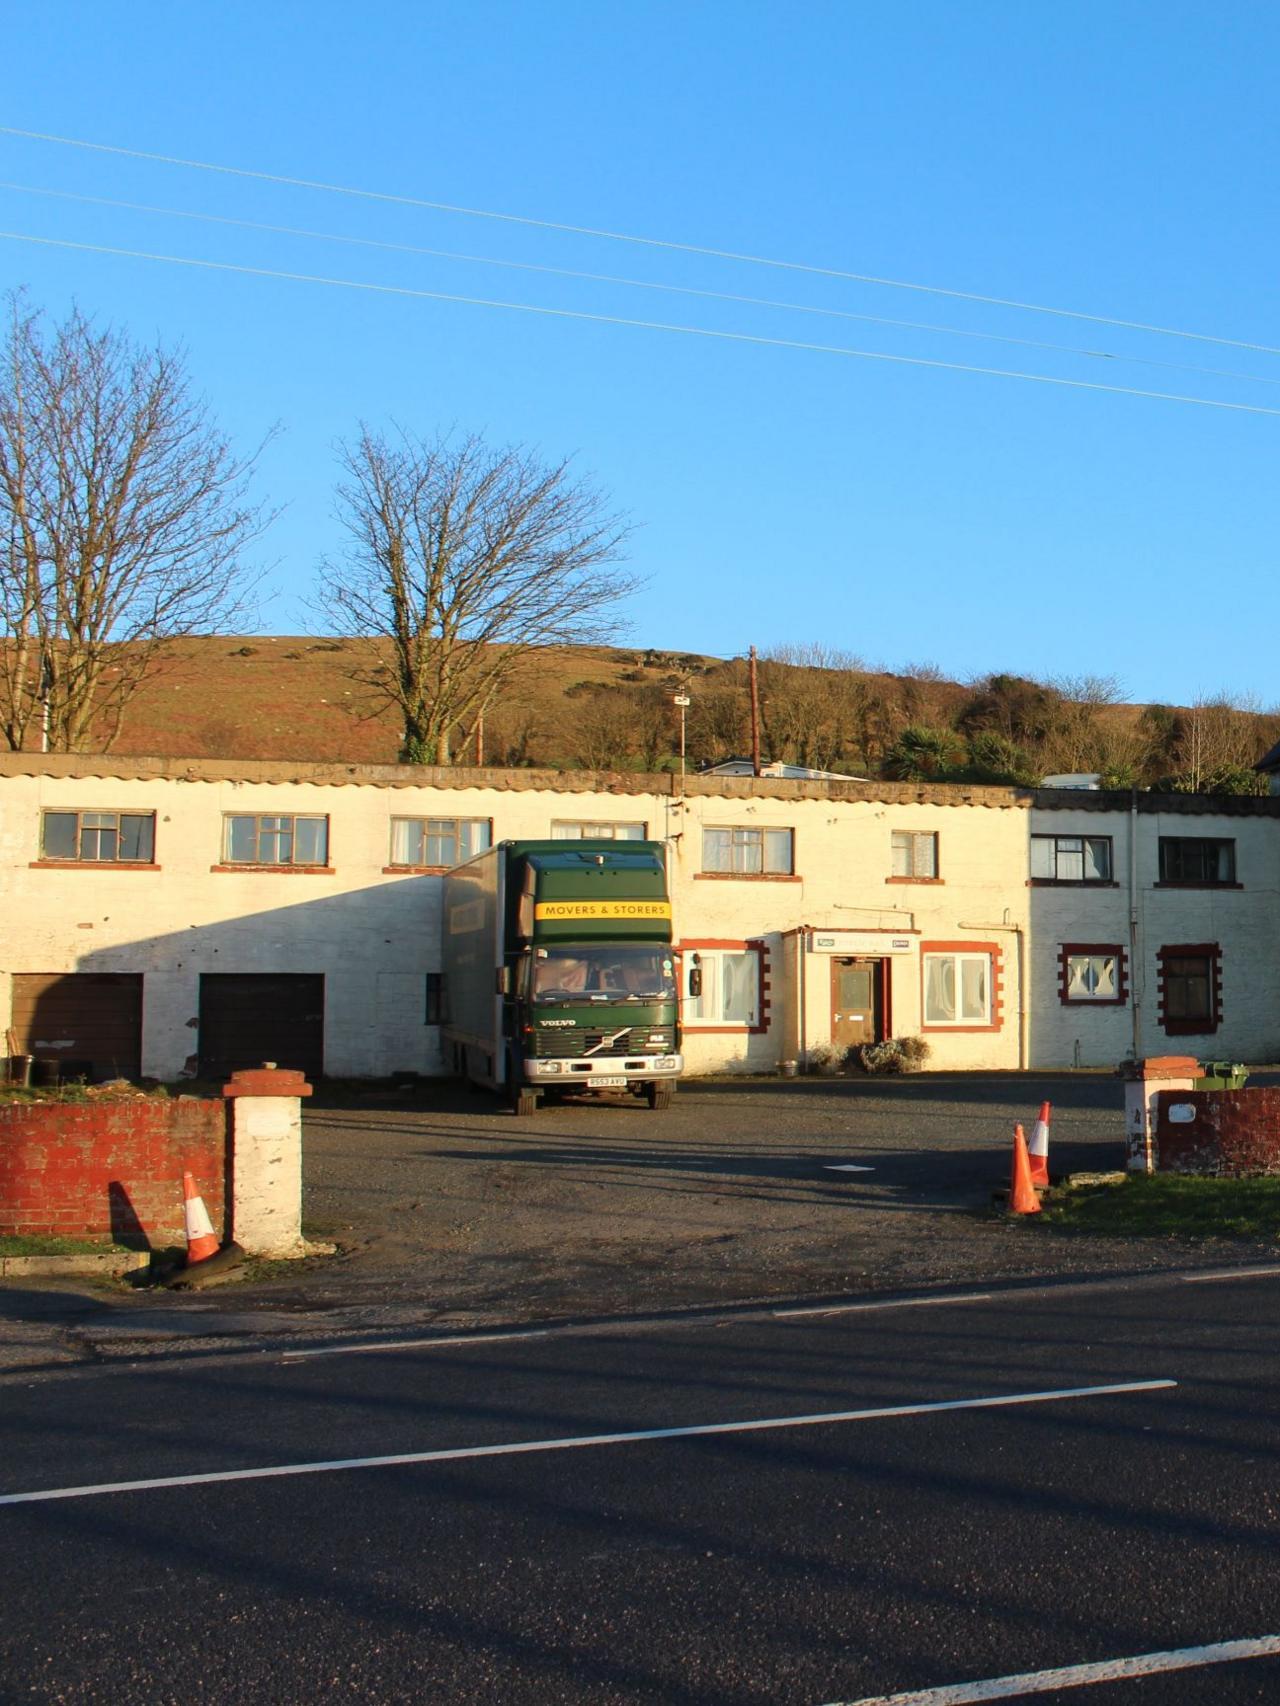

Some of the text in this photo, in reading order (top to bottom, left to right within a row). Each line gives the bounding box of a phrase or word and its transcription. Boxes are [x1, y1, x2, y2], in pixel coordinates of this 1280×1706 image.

[545, 905, 665, 915] MOVERS & STORERS
